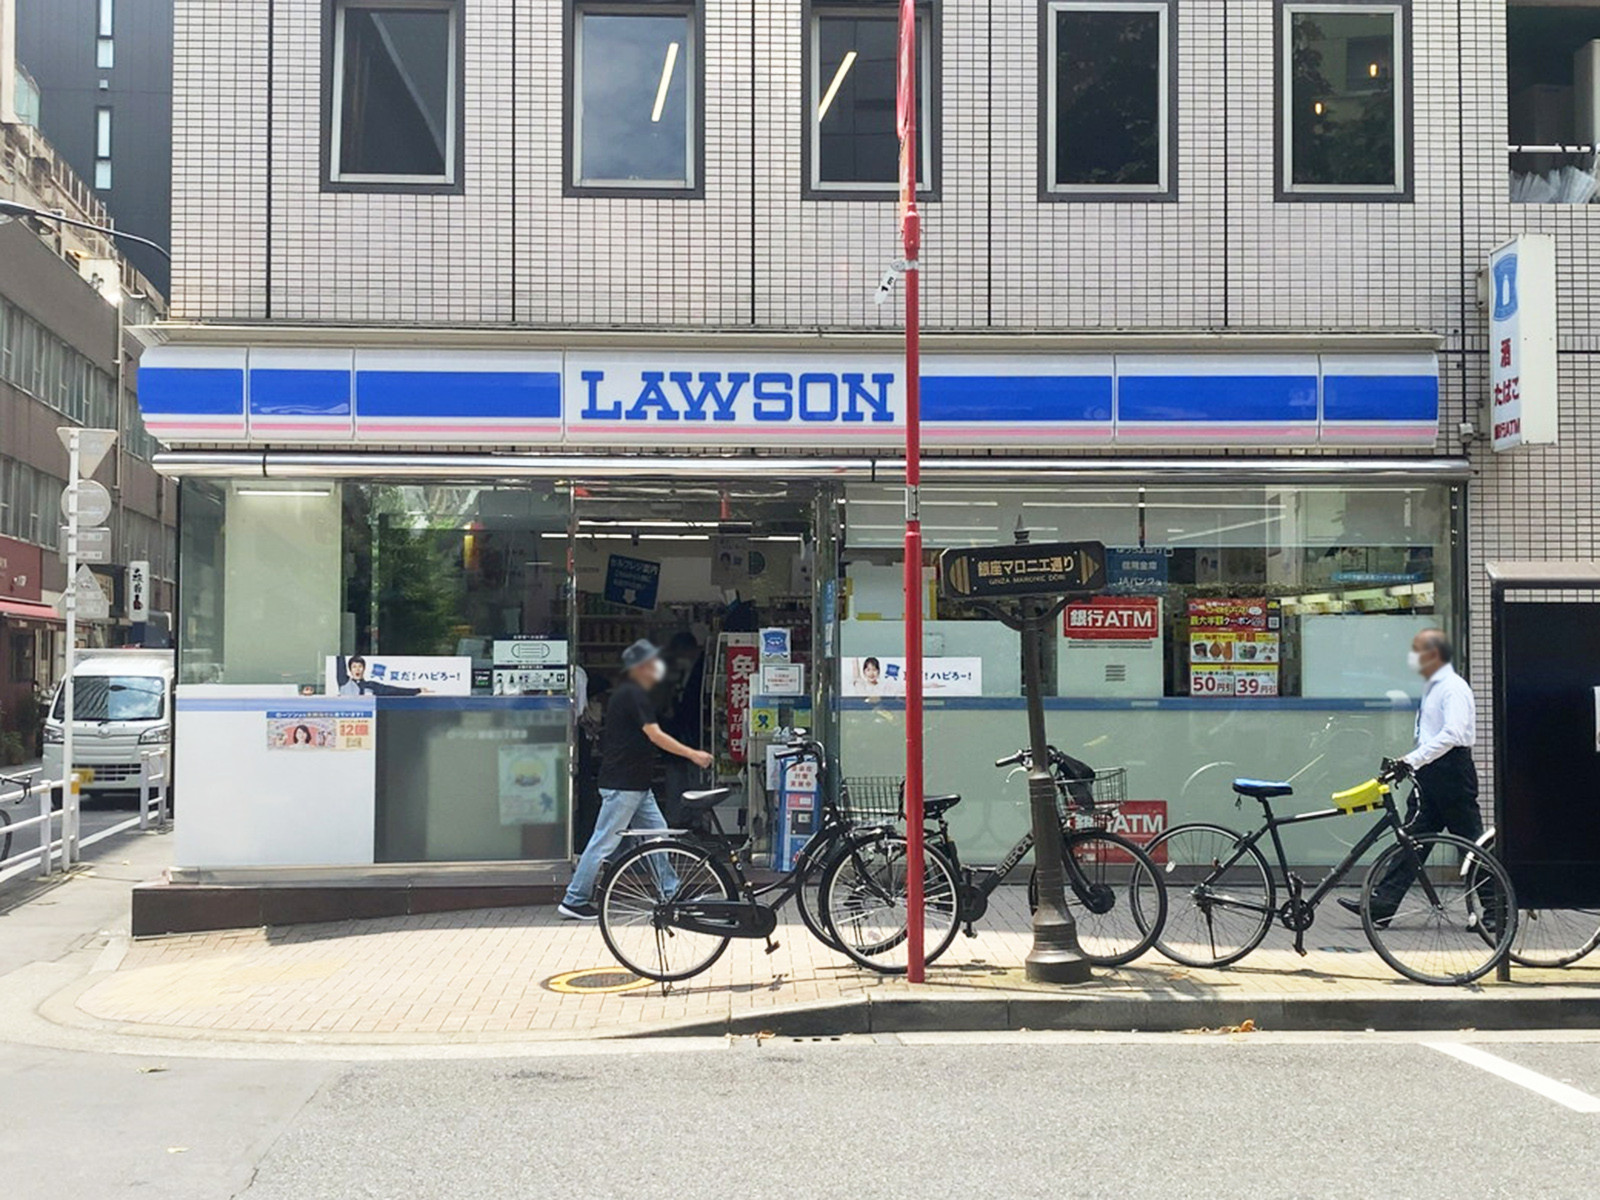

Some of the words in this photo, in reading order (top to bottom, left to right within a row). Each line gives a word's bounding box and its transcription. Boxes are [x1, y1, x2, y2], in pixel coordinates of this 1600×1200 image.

[1500, 338, 1511, 367] 酒
[581, 371, 894, 421] LAWSON
[1494, 377, 1520, 407] たばこ
[978, 556, 1075, 577] 銀座マロニエ通り
[1070, 609, 1152, 628] 銀行ATM
